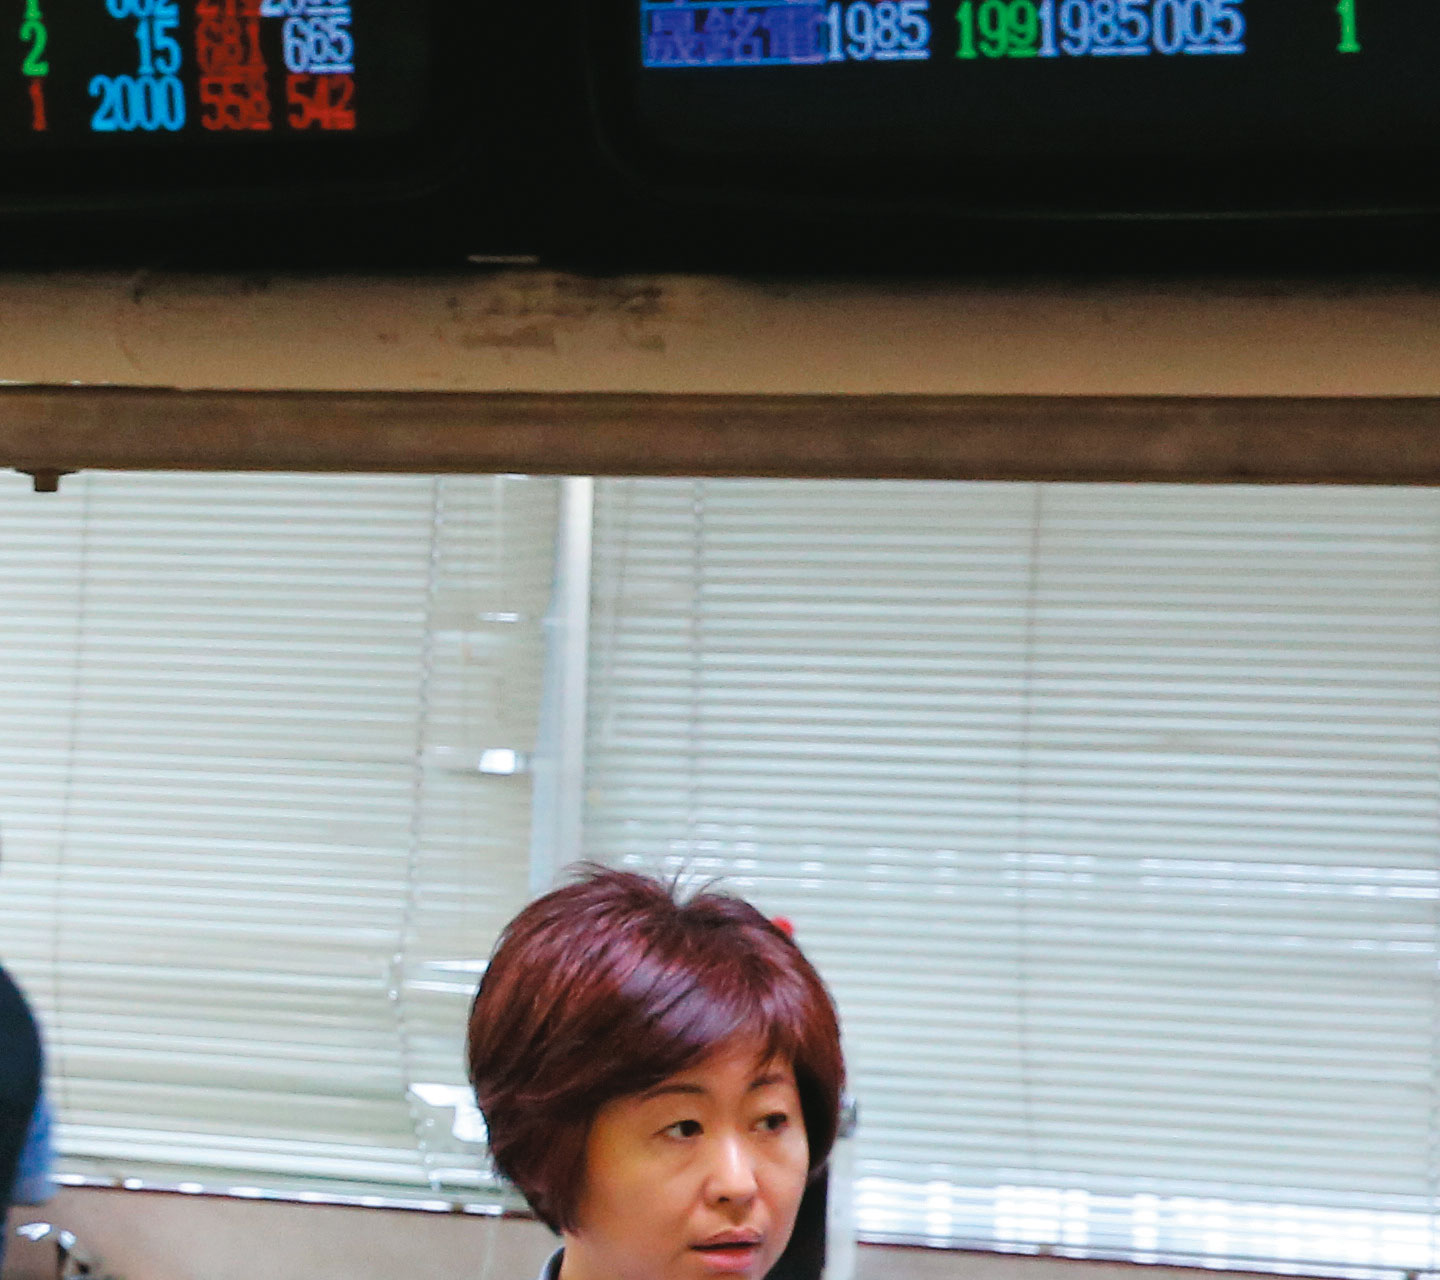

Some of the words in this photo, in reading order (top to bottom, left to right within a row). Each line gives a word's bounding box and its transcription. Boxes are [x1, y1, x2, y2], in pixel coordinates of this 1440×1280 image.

[135, 22, 180, 75] 15
[823, 2, 929, 59] 1985
[89, 76, 185, 131] 2000
